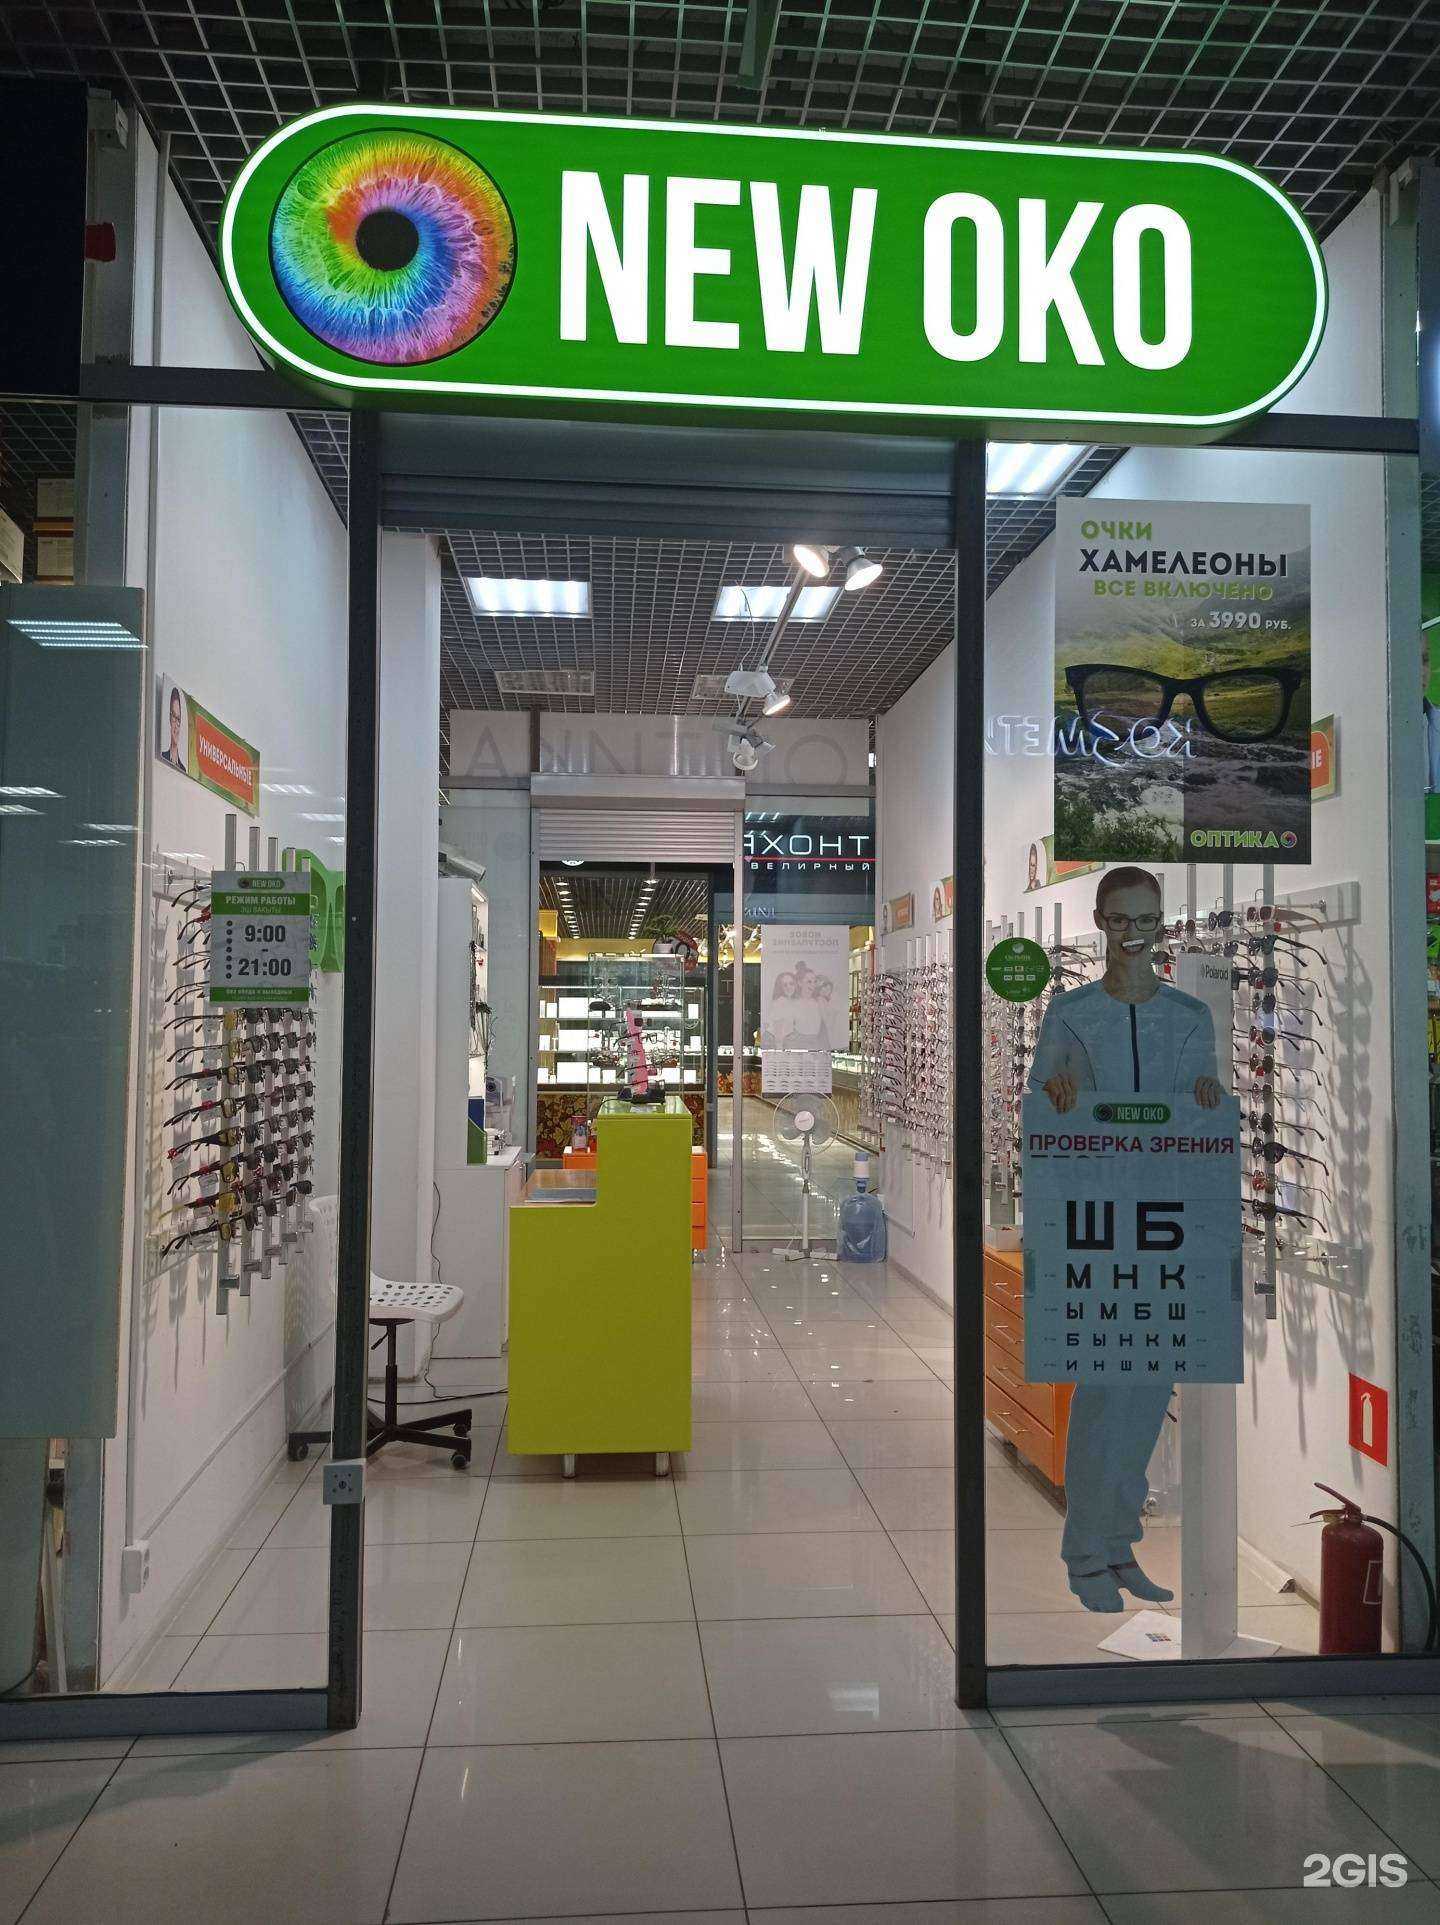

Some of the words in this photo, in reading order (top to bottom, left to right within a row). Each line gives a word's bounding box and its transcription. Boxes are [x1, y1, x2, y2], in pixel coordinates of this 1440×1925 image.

[560, 170, 878, 355] NEW
[923, 191, 1193, 370] OKO
[1080, 519, 1153, 541] ОЧКИ
[1079, 548, 1287, 577] ХАМЕЛЕОНЫ
[1094, 579, 1136, 597] ВСЕ
[1144, 580, 1273, 601] ВКЛЮЧЕНО
[1191, 618, 1206, 629] ЗА
[1209, 610, 1261, 630] 3990
[1265, 619, 1292, 631] РУБ.
[199, 734, 252, 786] УНИВЕРСАЛЬНЫЕ
[1190, 829, 1278, 849] ОПТИКА
[225, 896, 258, 904] РЕЖИМ
[260, 896, 296, 905] РАБОТЫ
[245, 925, 286, 942] 9:00
[238, 958, 292, 976] 21:00
[1117, 1107, 1140, 1121] NEW
[1143, 1107, 1164, 1121] OKO
[1029, 1134, 1144, 1152] ПРОВЕРКА
[1150, 1136, 1234, 1154] ЗРЕНИЯ
[1066, 1200, 1114, 1250] Ш
[1136, 1202, 1184, 1250] Б
[1066, 1263, 1091, 1288] М
[1114, 1264, 1138, 1289] Н
[1160, 1264, 1185, 1289] К
[1066, 1302, 1083, 1320] Ы
[1100, 1302, 1117, 1320] М
[1134, 1302, 1152, 1320] Б
[1168, 1302, 1185, 1320] Ш
[1066, 1333, 1080, 1346] Б
[1093, 1333, 1106, 1346] Ы
[1119, 1333, 1132, 1346] Н
[1146, 1333, 1159, 1347] К
[1172, 1333, 1186, 1347] М
